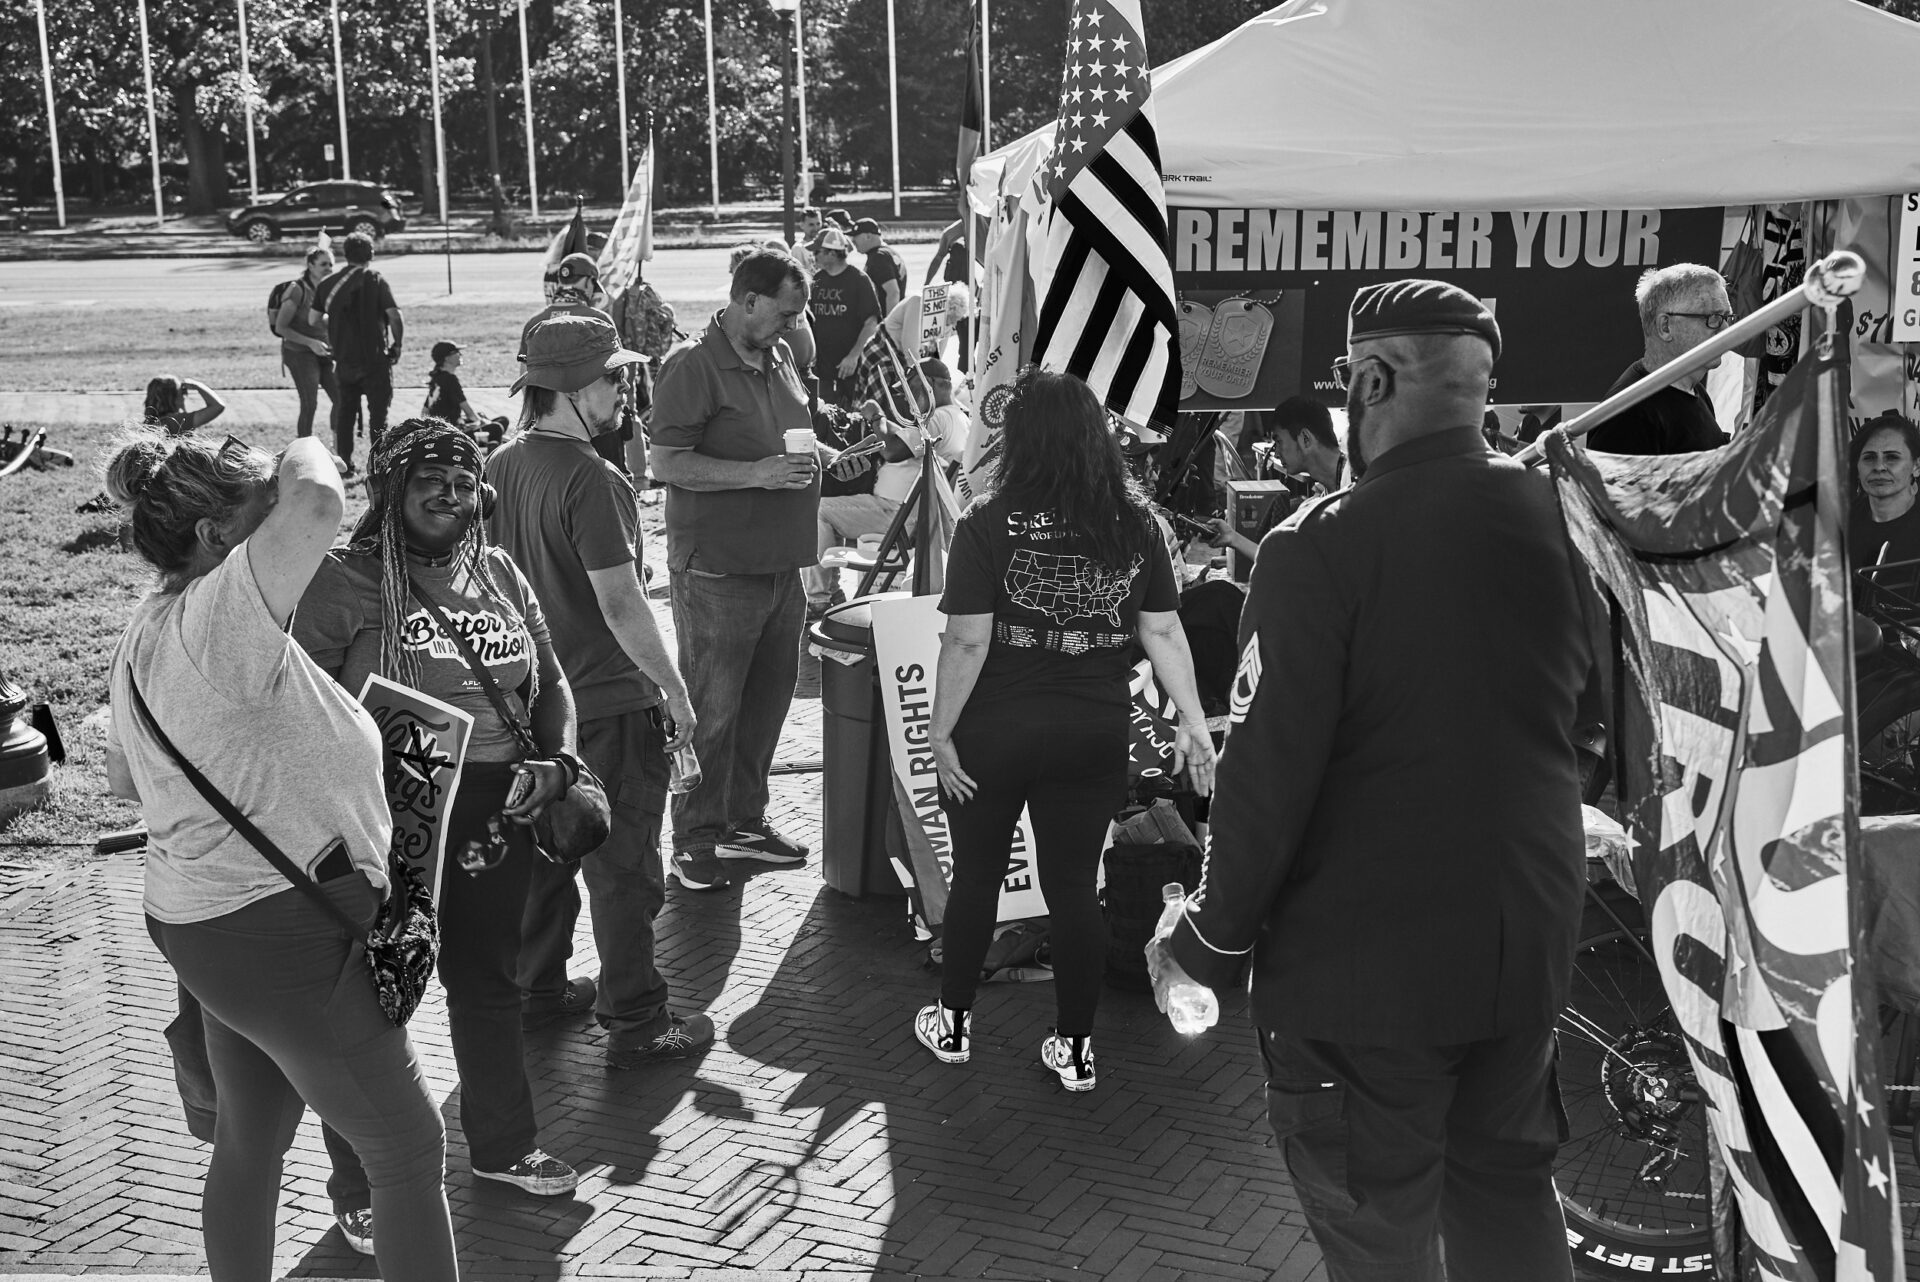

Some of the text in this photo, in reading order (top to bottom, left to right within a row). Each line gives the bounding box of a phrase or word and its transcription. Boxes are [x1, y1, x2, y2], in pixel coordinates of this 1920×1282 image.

[1175, 208, 1662, 272] REMEMBER YOUR
[818, 288, 842, 301] FUCK
[928, 288, 946, 298] THIS
[814, 302, 848, 317] TRUMP
[923, 299, 946, 313] IS NOT
[931, 316, 938, 326] A
[1200, 366, 1223, 380] YOUR
[1201, 358, 1253, 377] REMEMBER
[432, 640, 447, 654] IN
[895, 662, 938, 777] RIGHTS
[1585, 1244, 1655, 1273] BFT
